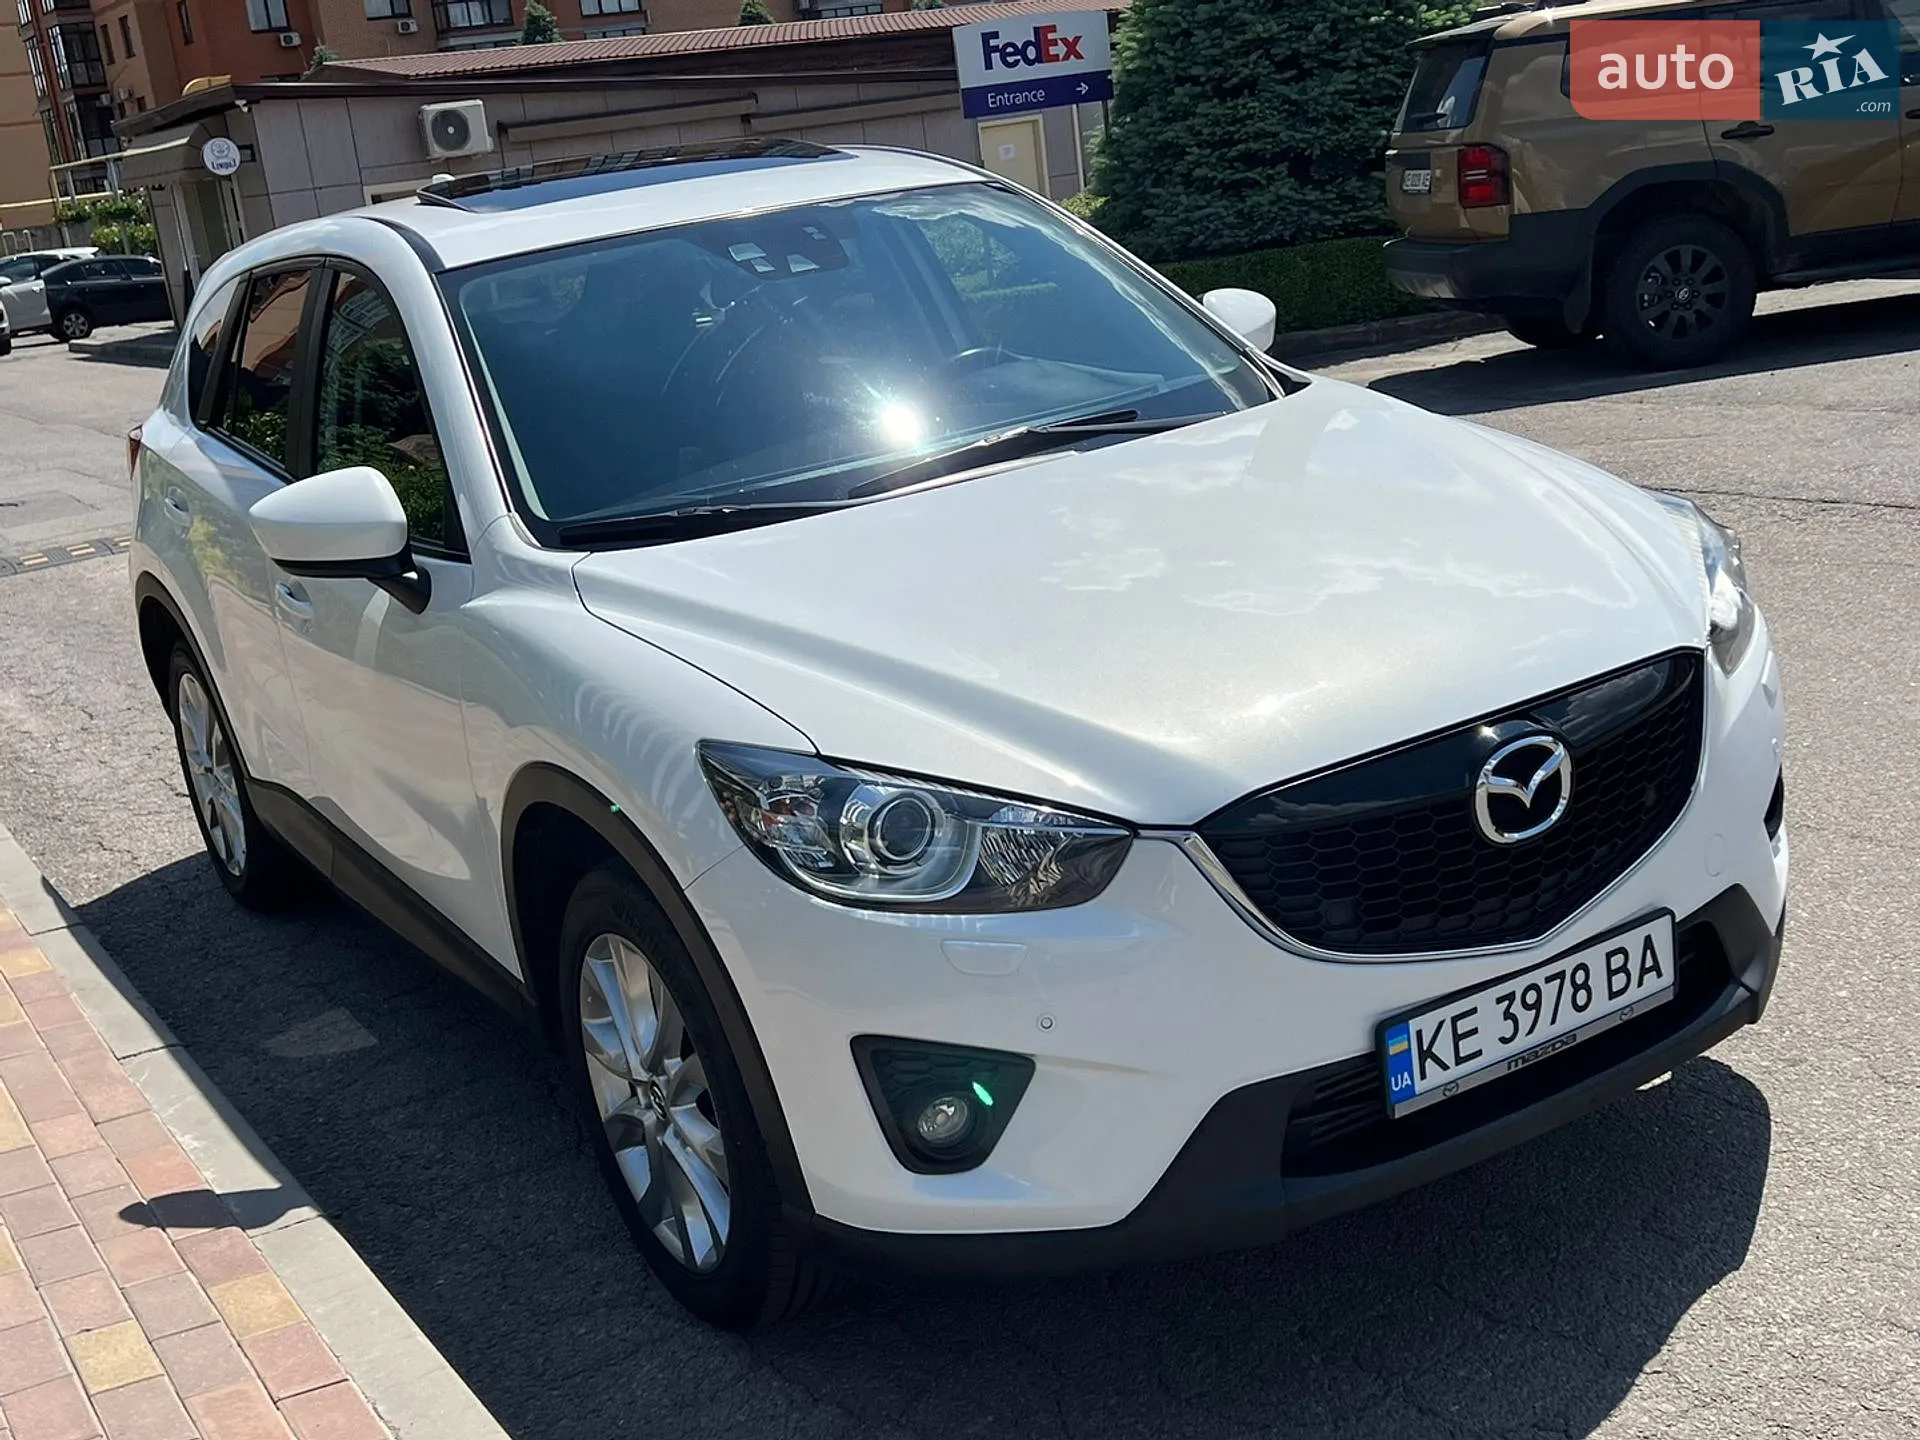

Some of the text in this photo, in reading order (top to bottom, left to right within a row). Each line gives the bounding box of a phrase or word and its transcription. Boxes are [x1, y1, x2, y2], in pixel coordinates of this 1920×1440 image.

[980, 24, 1085, 71] FedEx
[987, 88, 1046, 109] Entrance
[1415, 934, 1663, 1081] KE 3978 BA
[1391, 1071, 1412, 1091] UA
